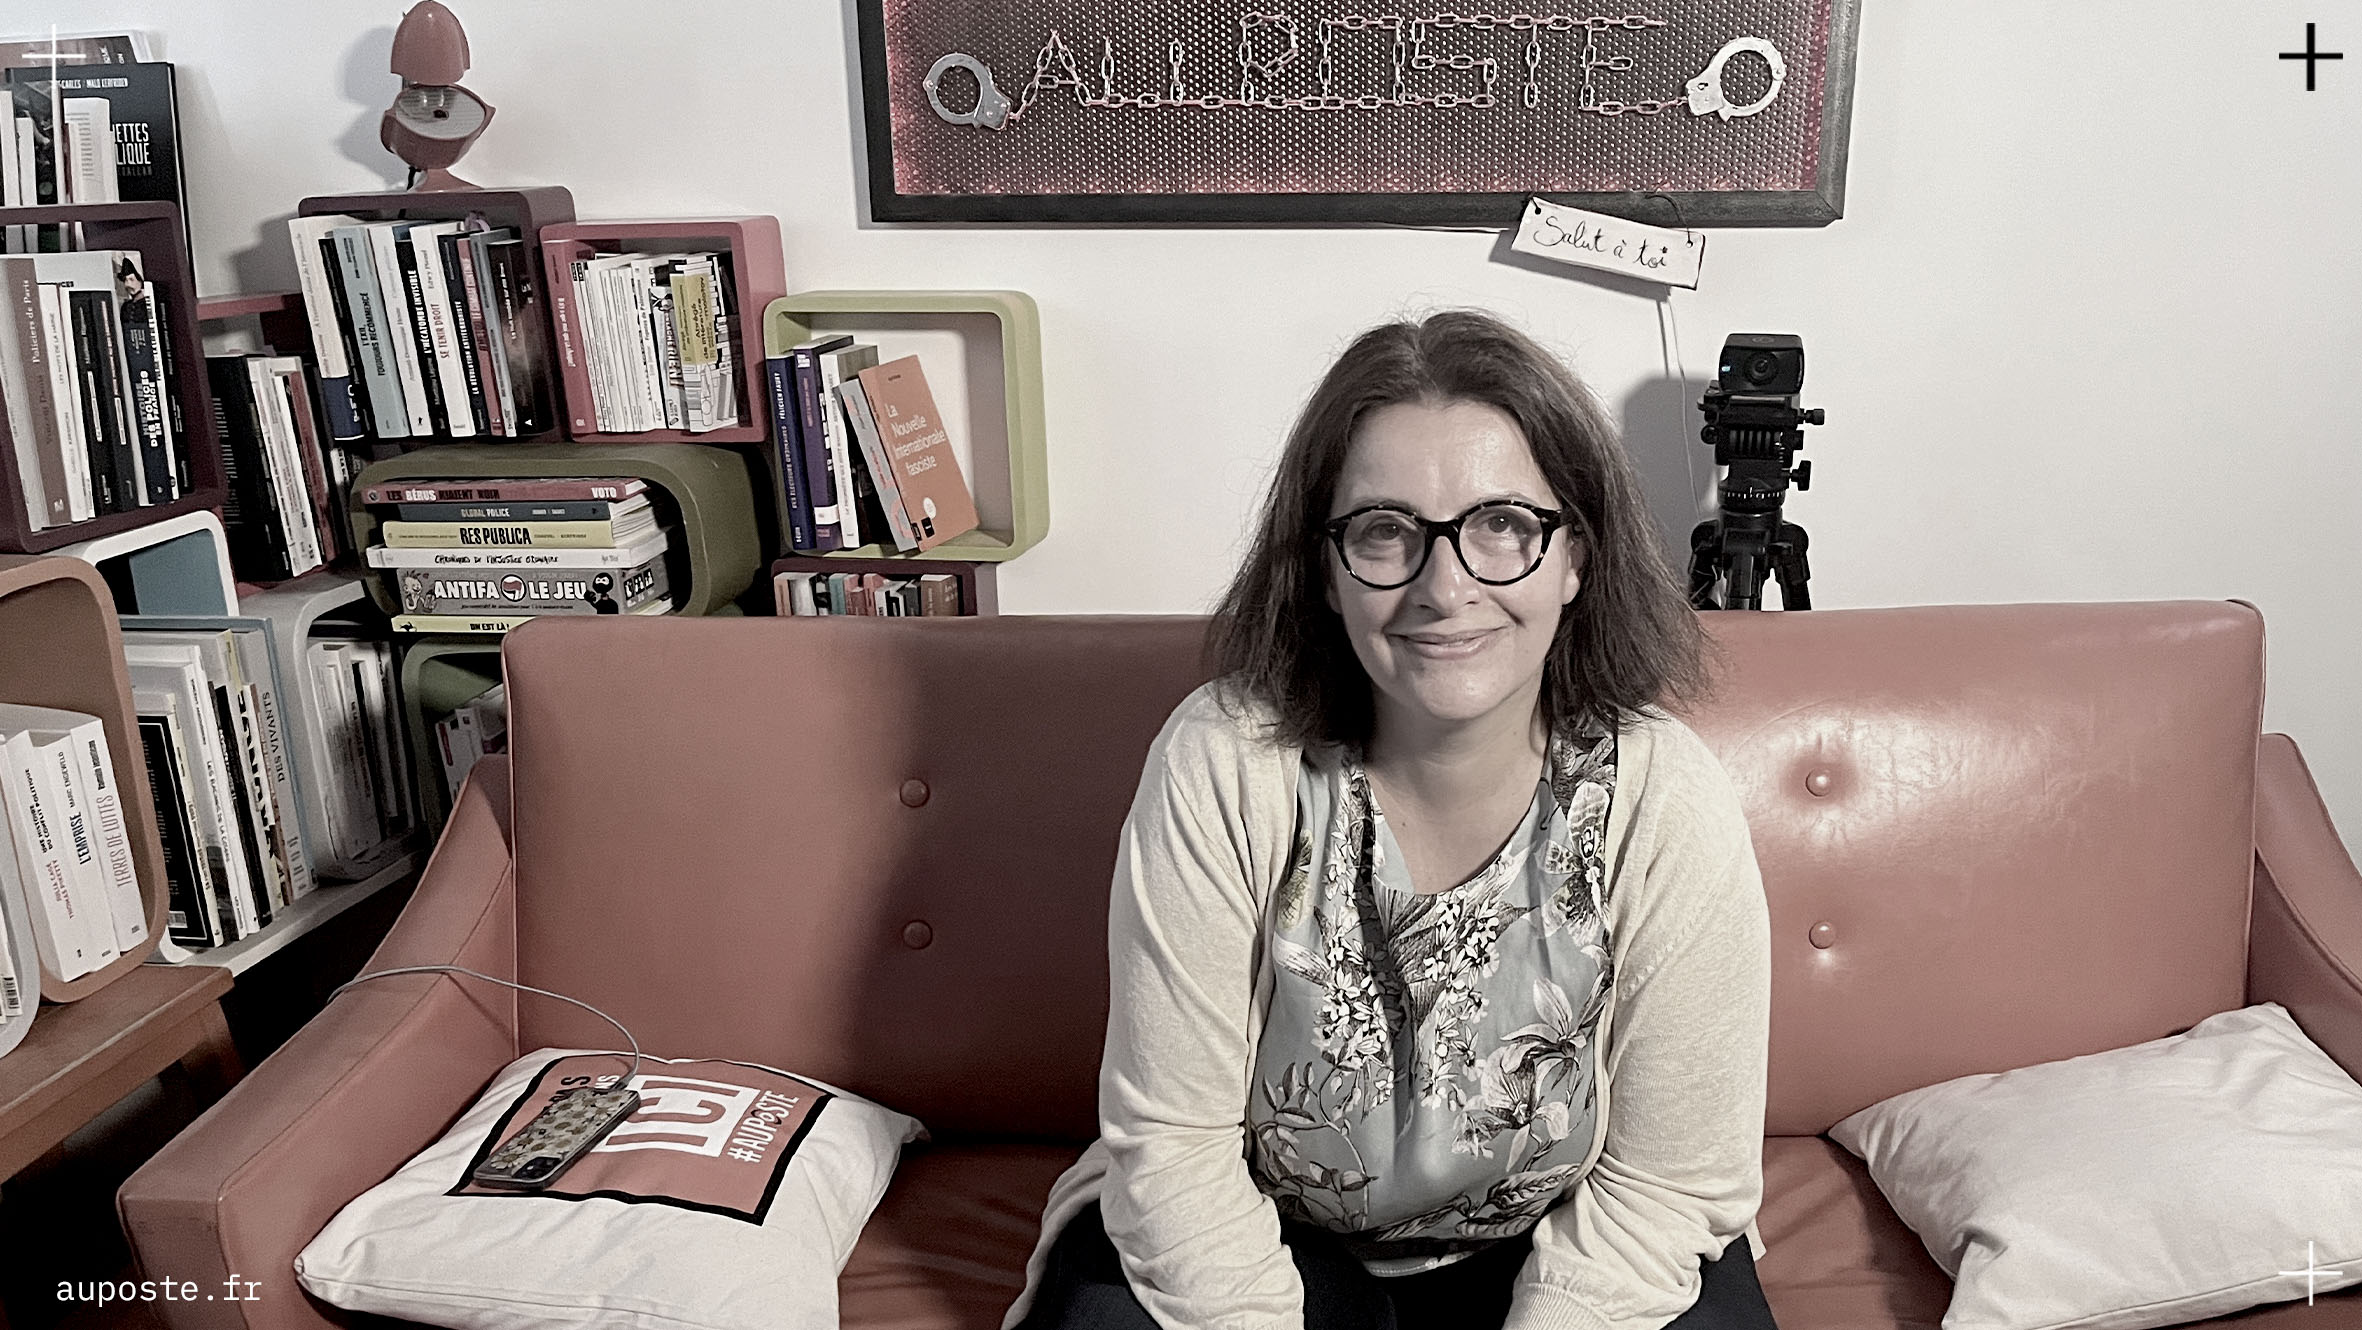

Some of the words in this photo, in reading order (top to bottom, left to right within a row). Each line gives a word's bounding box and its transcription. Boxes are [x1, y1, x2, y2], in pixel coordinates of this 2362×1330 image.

[112, 123, 149, 142] ETTES
[116, 143, 152, 164] LIQUE
[1533, 216, 1604, 252] Salut
[1633, 239, 1668, 268] toi
[23, 280, 32, 303] Paris
[407, 270, 422, 305] INVISIBLE
[25, 307, 34, 319] de
[430, 303, 443, 326] DROIT
[29, 321, 40, 363] Policiers
[415, 307, 432, 354] L'HÉCATOMBE
[435, 327, 447, 348] TENIR
[439, 351, 450, 359] SE
[140, 371, 156, 421] POLICES
[147, 381, 160, 420] FRANCE
[147, 423, 158, 447] DES
[891, 415, 927, 438] Nouvelle
[906, 455, 937, 476] fasciste
[406, 488, 437, 501] BÉRUS
[486, 508, 510, 517] POLICE
[460, 528, 482, 545] RES
[483, 527, 532, 545] PUBLICA
[434, 580, 500, 600] ANTIFA
[528, 581, 550, 600] LE
[553, 581, 587, 600] JEU
[262, 692, 279, 753] VIVANTS
[275, 755, 285, 782] DES
[66, 788, 75, 807] MARC
[37, 809, 50, 838] CONFLIT
[96, 795, 120, 832] LUTTES
[46, 839, 53, 849] DU
[69, 811, 92, 864] L'EMPRISE
[106, 833, 123, 848] DE
[109, 848, 133, 887] TERRES
